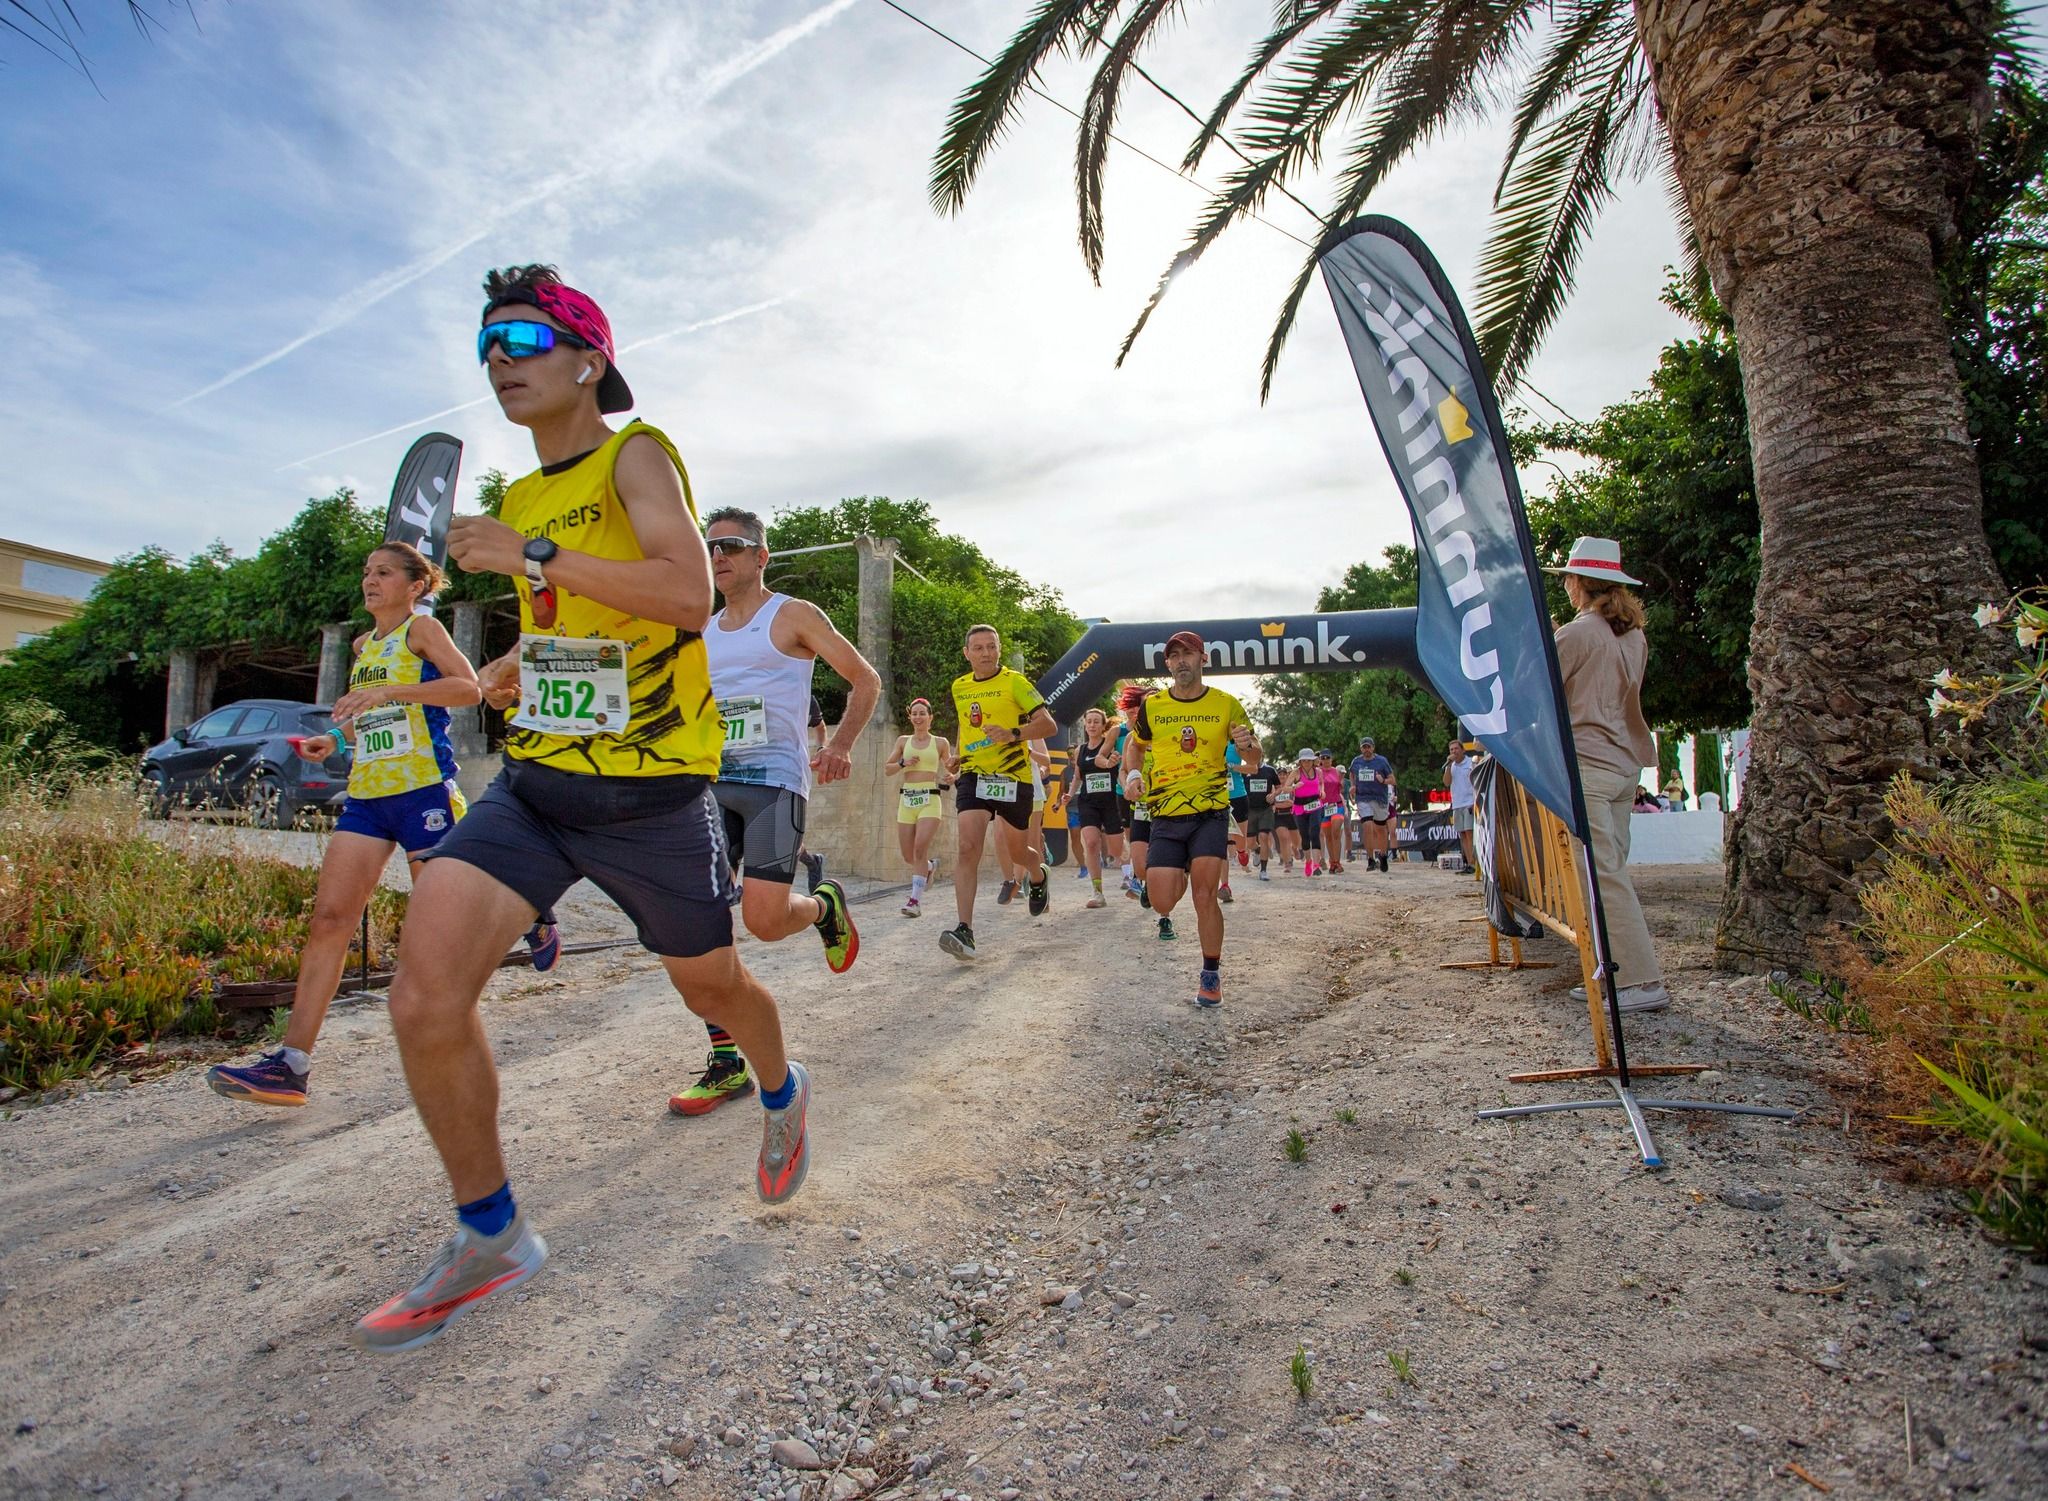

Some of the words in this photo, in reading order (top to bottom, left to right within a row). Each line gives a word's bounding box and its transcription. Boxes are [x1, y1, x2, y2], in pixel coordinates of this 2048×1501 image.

[1143, 620, 1367, 670] rnnink.
[357, 665, 387, 684] Mafia
[1045, 652, 1099, 705] unnink.com
[537, 678, 596, 719] 252
[1154, 715, 1220, 725] Paparunners
[365, 730, 394, 754] 200
[986, 784, 1006, 797] 231
